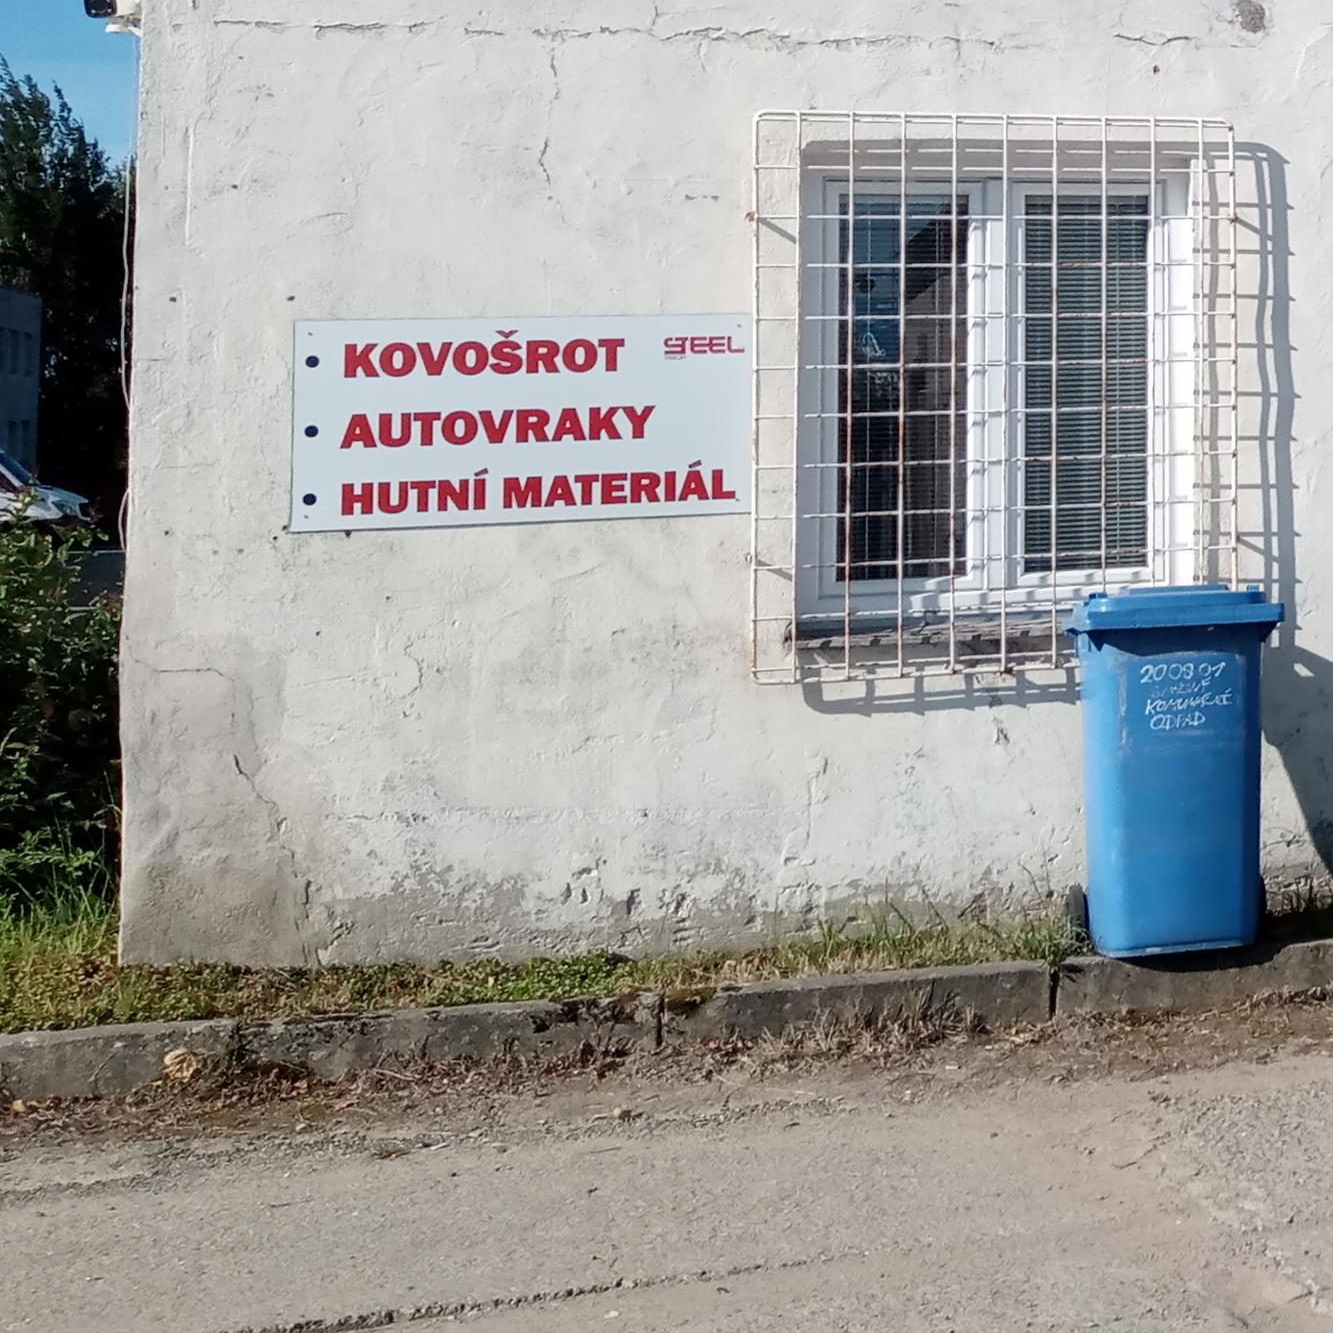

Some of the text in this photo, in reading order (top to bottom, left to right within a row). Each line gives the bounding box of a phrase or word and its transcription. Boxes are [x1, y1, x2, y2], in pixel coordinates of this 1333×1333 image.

[342, 329, 626, 379] KOVOŠROT
[664, 336, 745, 355] STEEL
[339, 404, 656, 449] AUTOVRAKY
[340, 459, 737, 517] HUTNÍ MATERIÁL
